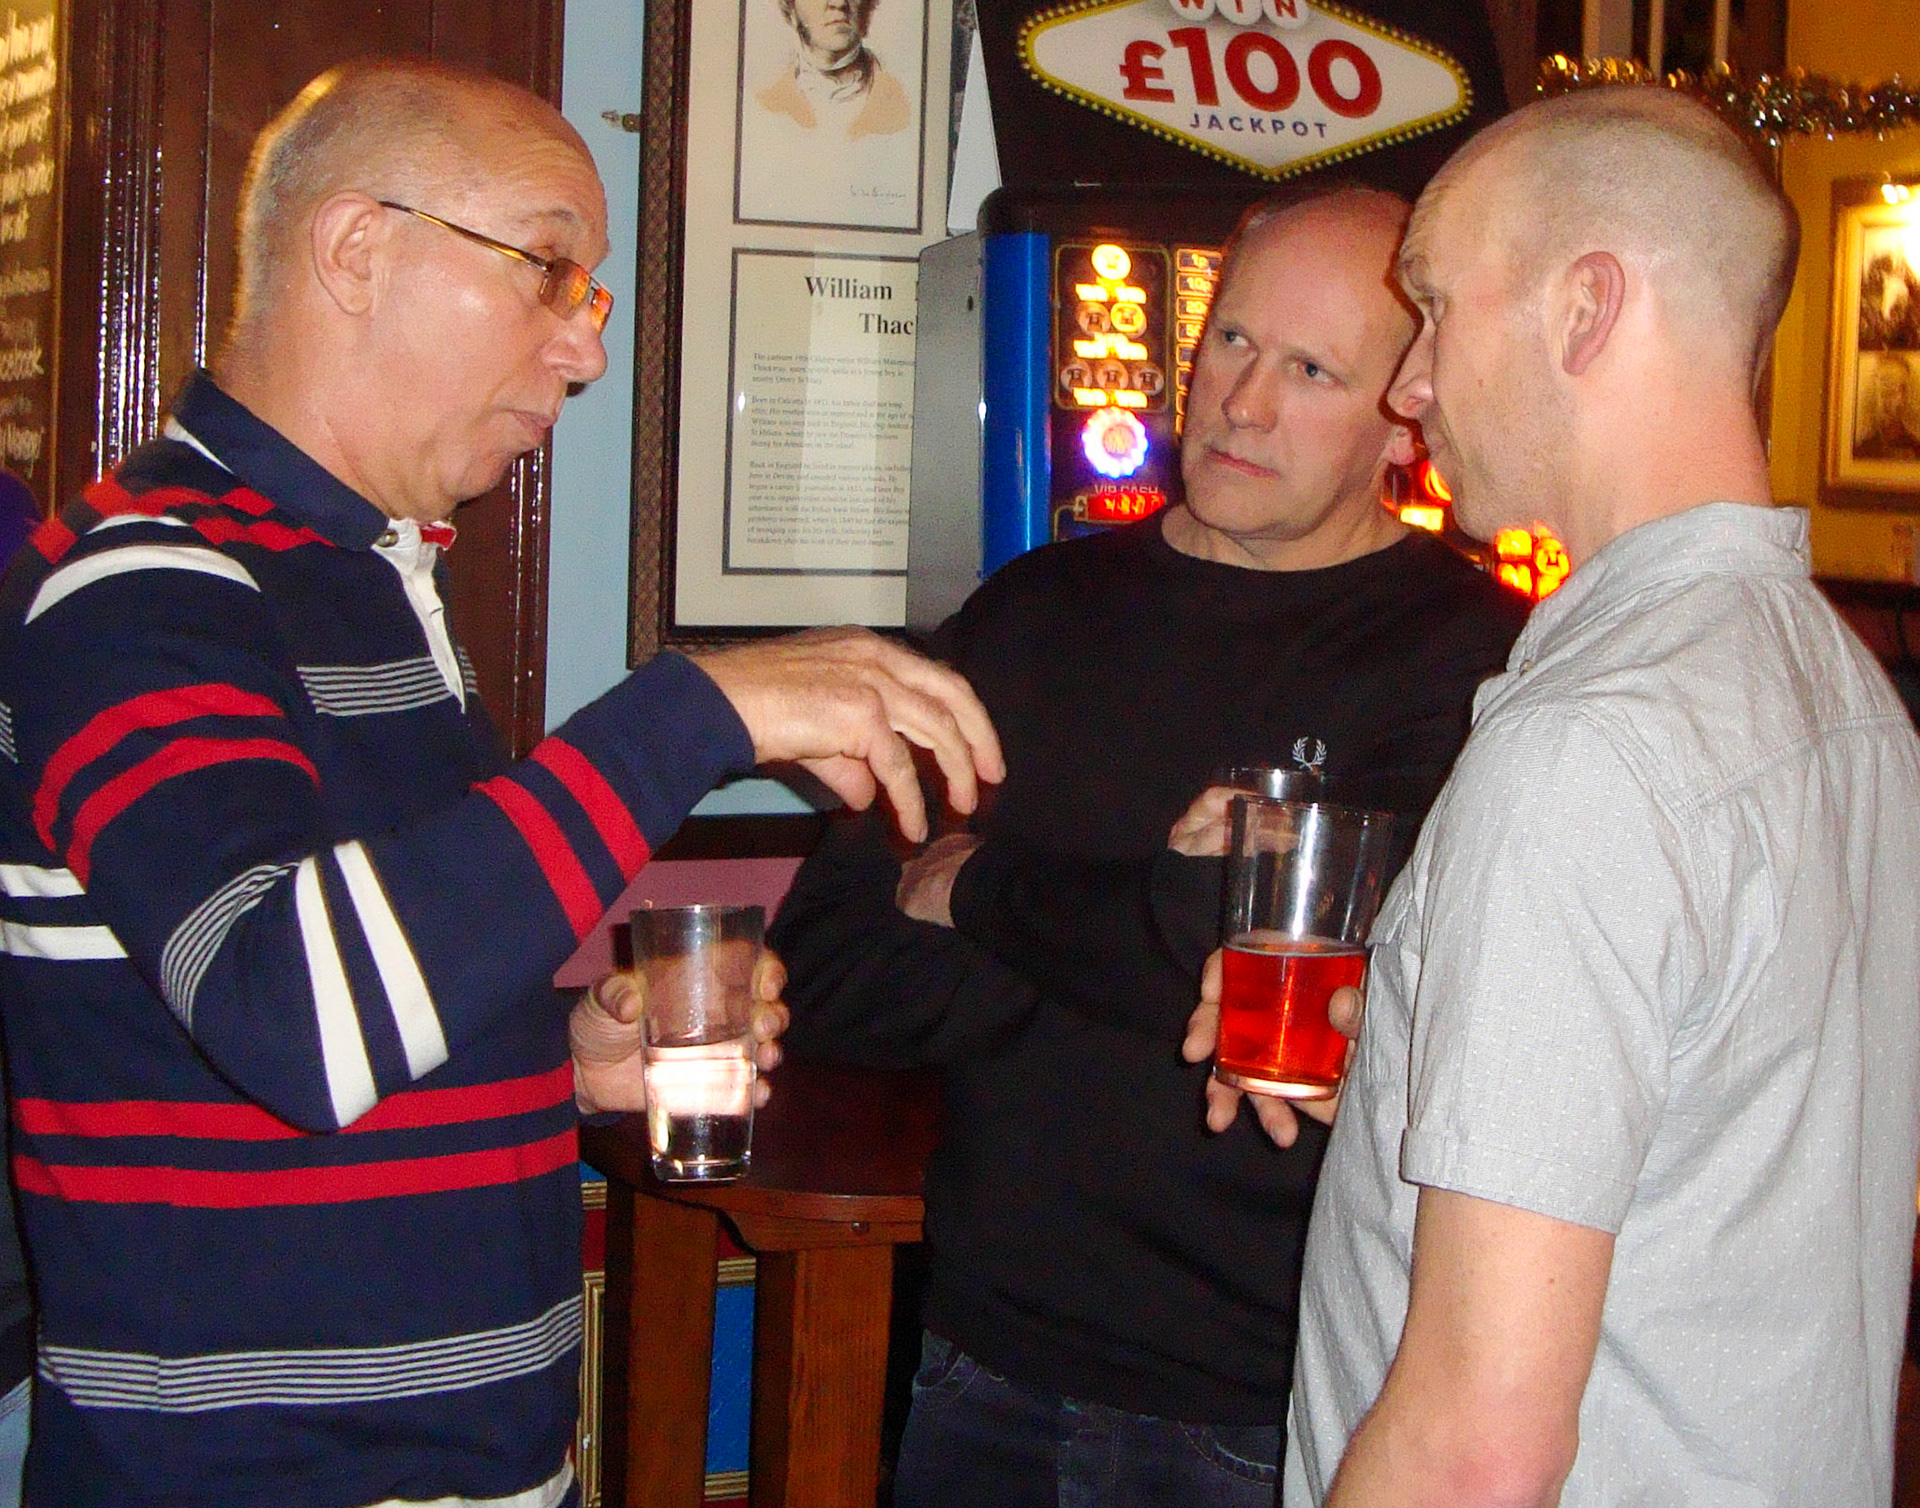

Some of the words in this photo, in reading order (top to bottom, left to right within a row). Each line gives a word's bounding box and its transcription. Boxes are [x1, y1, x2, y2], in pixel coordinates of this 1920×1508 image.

[1119, 26, 1383, 119] £100
[1189, 112, 1329, 139] JACKPOT
[805, 276, 893, 300] William
[859, 312, 914, 335] Thac
